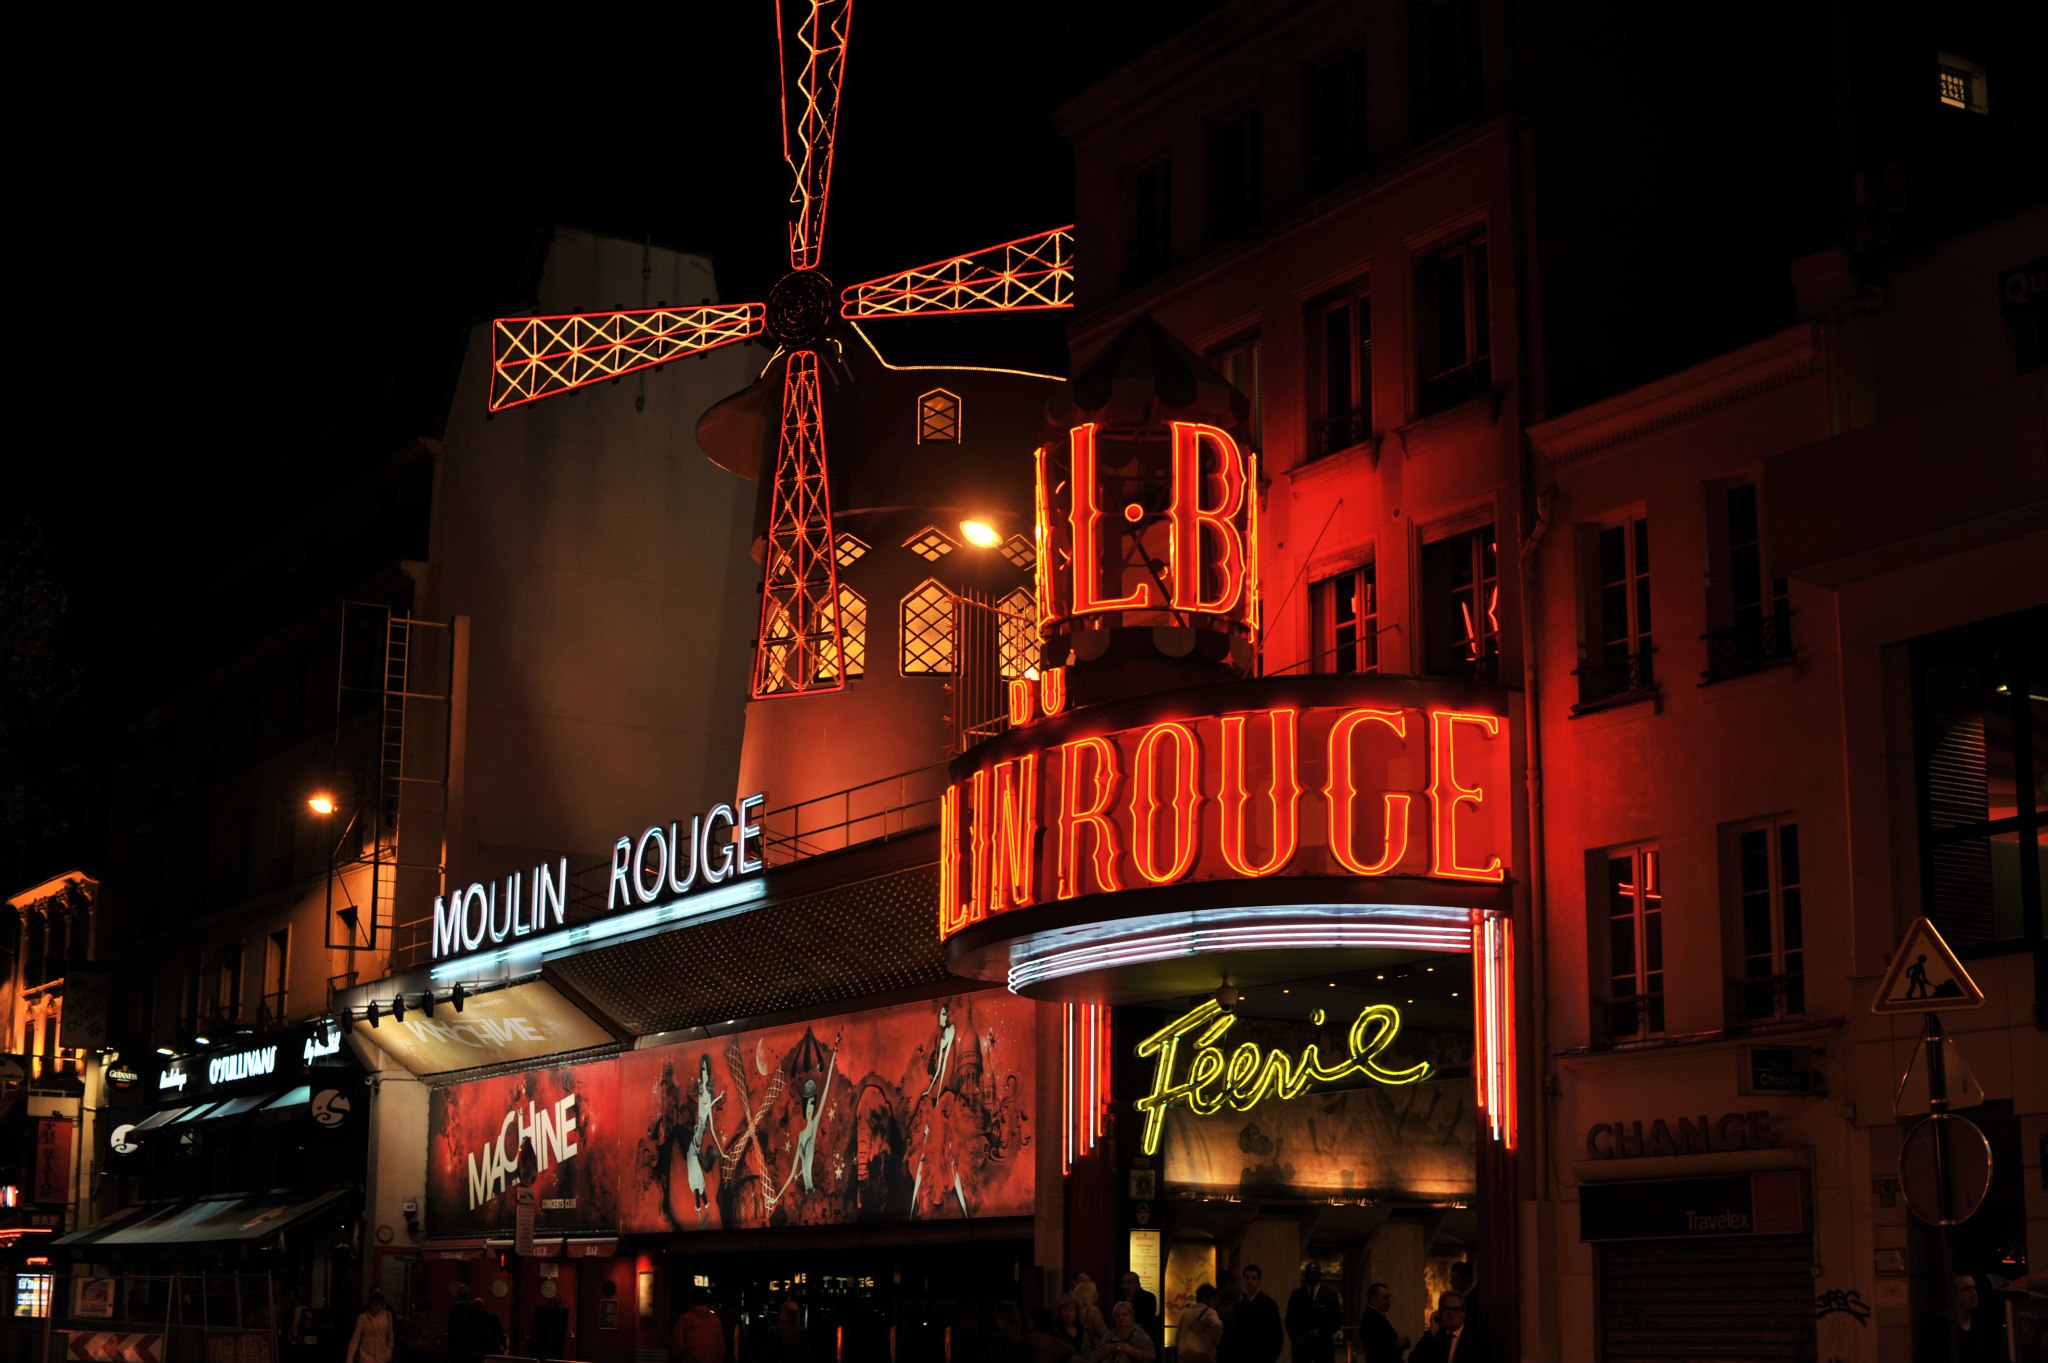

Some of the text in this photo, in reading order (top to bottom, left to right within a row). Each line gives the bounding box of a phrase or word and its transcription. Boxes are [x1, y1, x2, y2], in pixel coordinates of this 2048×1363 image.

[1009, 667, 1064, 726] DU
[941, 707, 1506, 942] LIN ROUGE
[431, 790, 769, 959] MOULIN ROUGE
[108, 1069, 139, 1081] GUINNESS
[467, 1093, 578, 1211] MACHINE
[1586, 1110, 1776, 1160] CHANGE
[32, 1215, 58, 1226] BAR
[1684, 1208, 1750, 1231] Travelex
